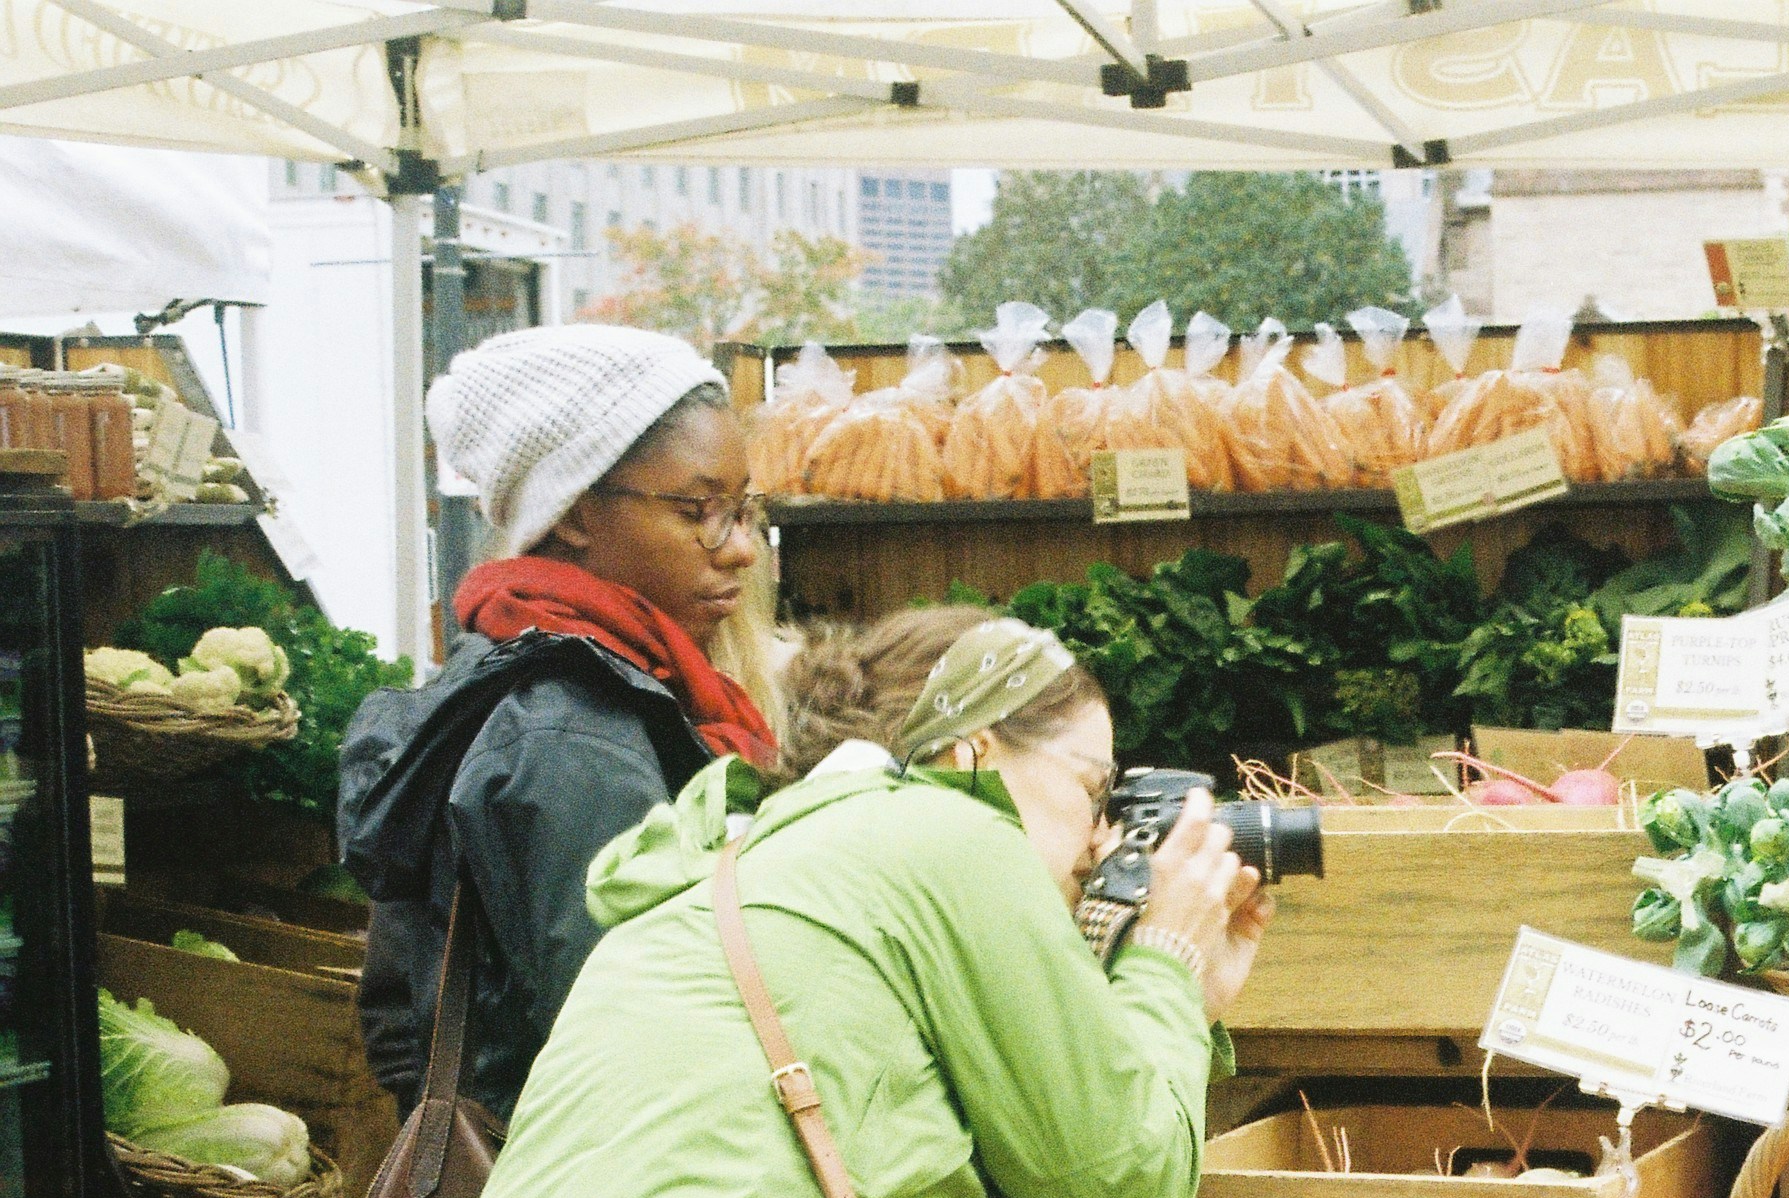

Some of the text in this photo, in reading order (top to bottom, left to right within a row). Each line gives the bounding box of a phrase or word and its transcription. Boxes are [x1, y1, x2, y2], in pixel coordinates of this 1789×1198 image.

[1682, 653, 1741, 667] TURNIPS
[1675, 680, 1715, 694] $2.50
[1563, 960, 1674, 1004] WATERMELON
[1573, 985, 1651, 1018] RADISHES
[1685, 989, 1779, 1033] Loose Carrots
[1562, 1012, 1610, 1037] $2.50
[1678, 1018, 1747, 1051] $2.00
